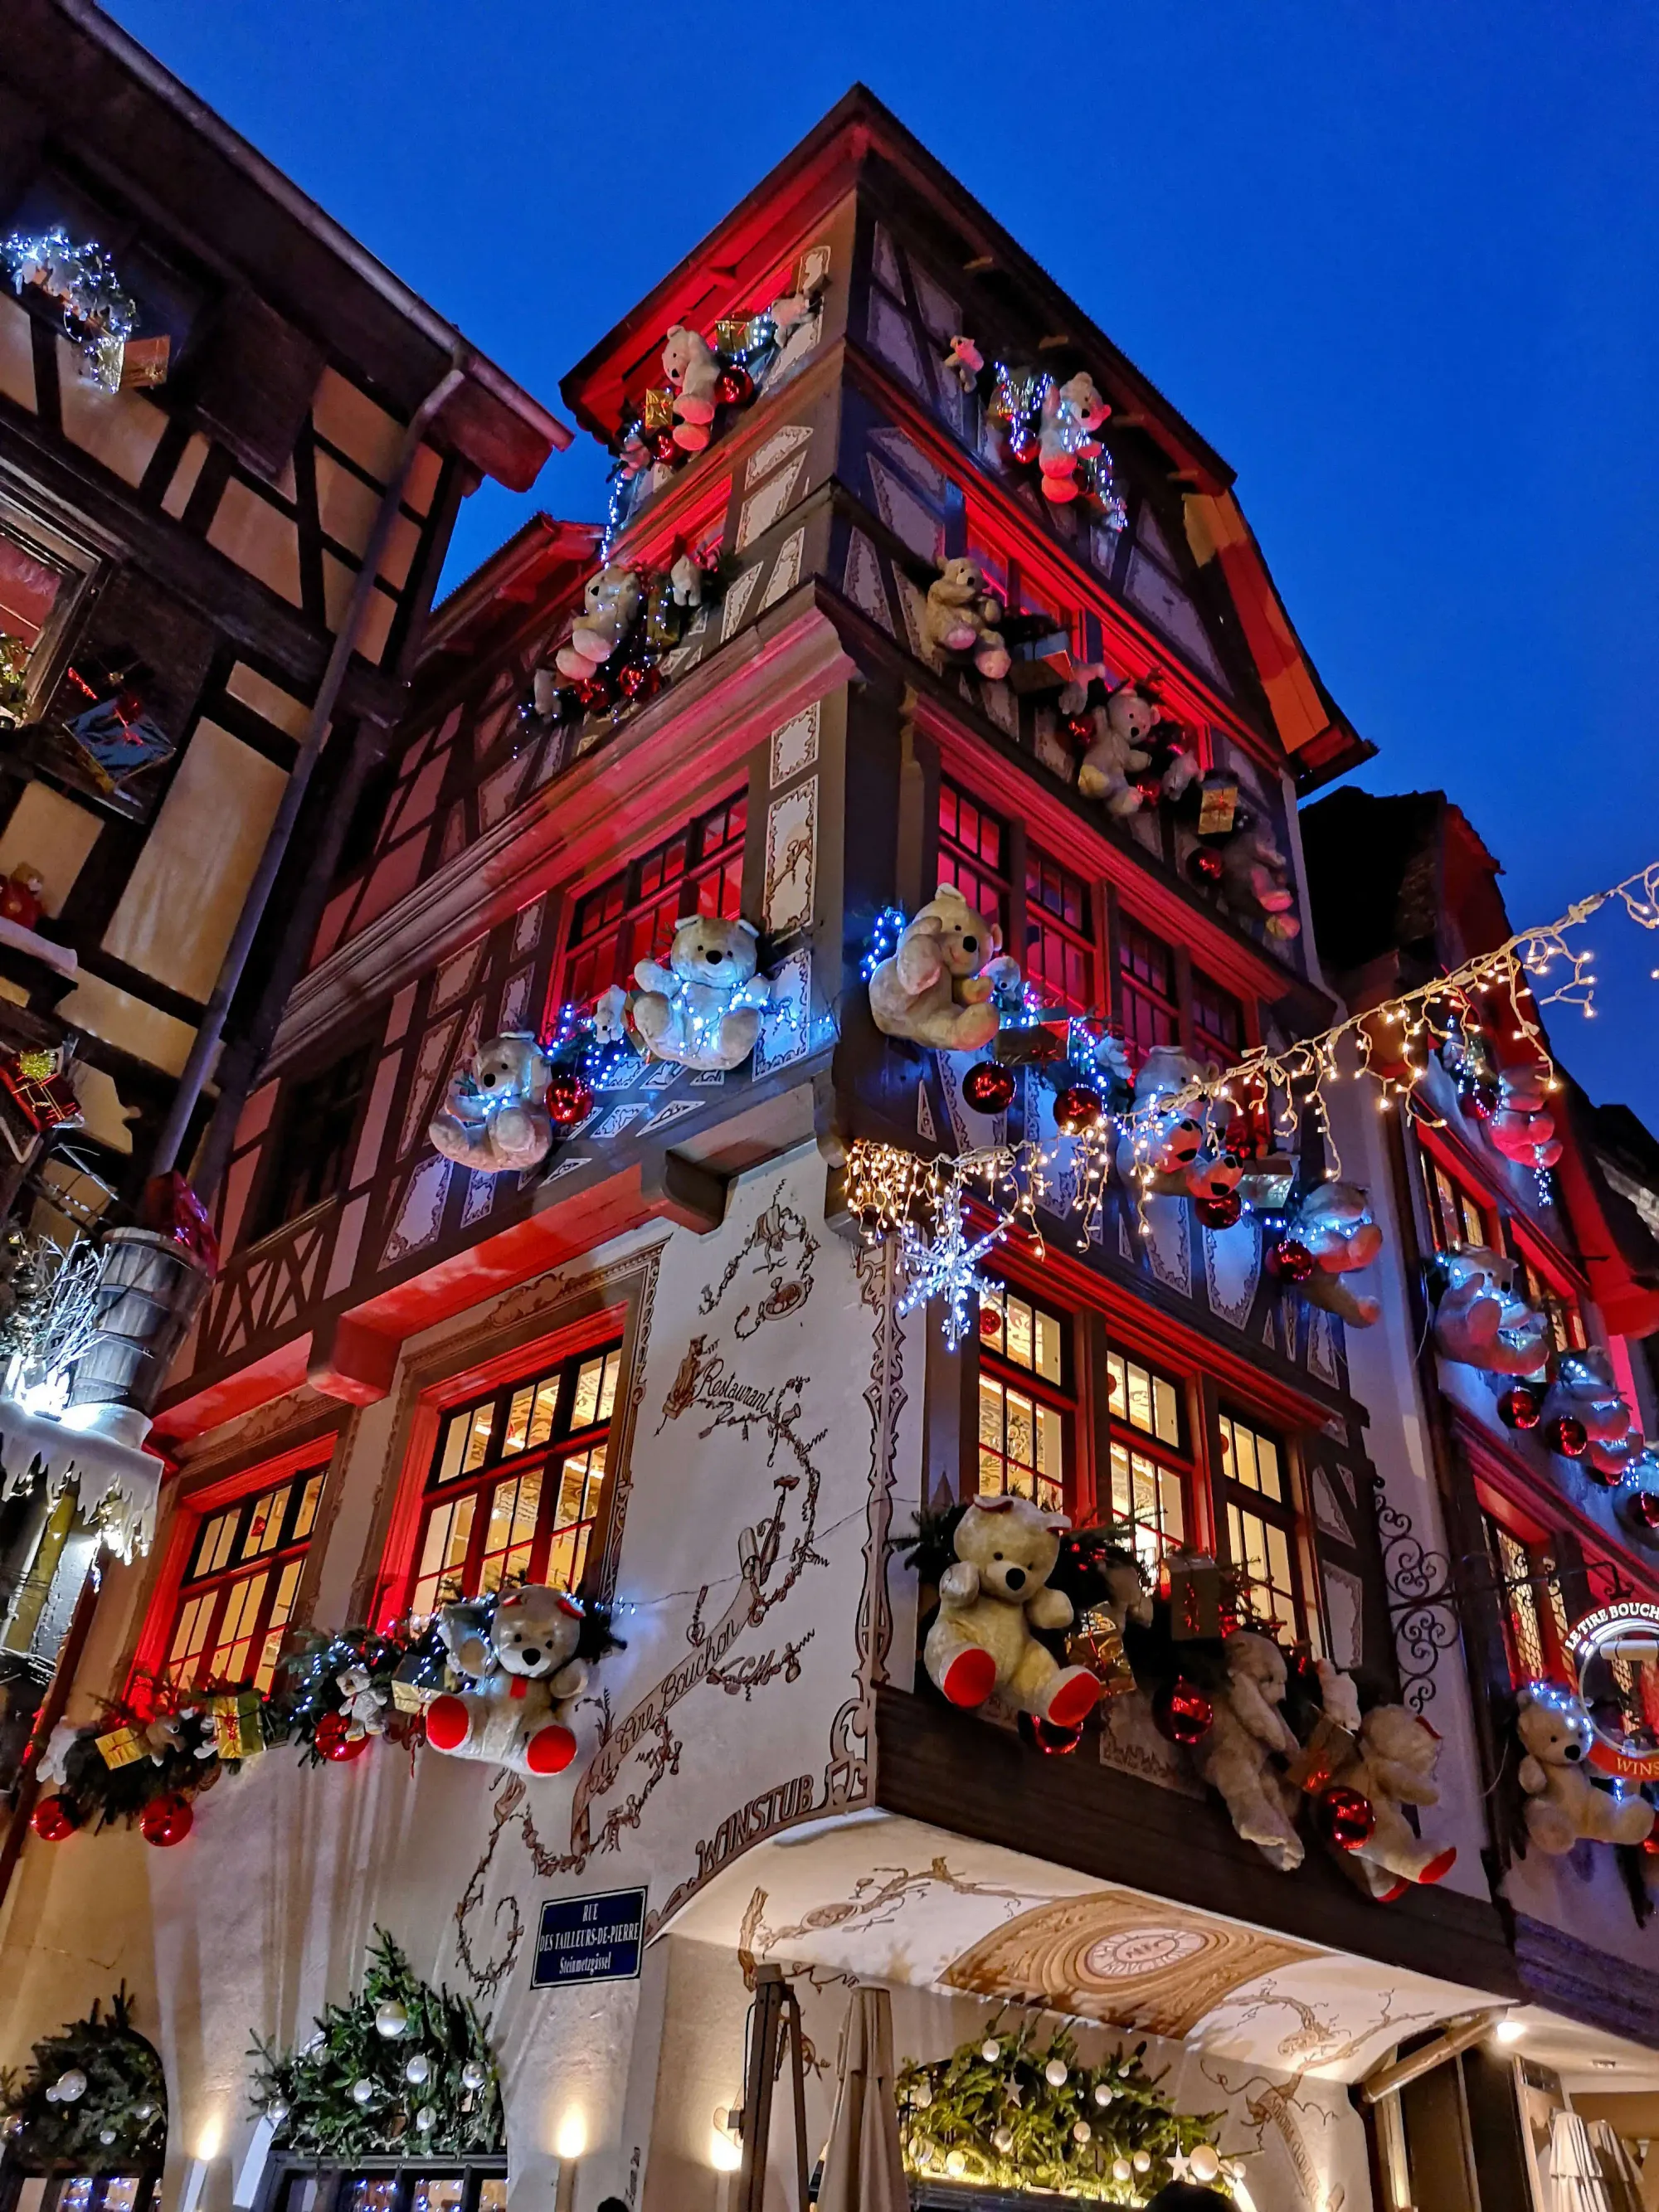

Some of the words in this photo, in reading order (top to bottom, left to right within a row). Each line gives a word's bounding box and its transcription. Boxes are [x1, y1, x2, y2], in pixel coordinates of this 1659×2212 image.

[694, 1357, 776, 1413] Restaurant
[1564, 1630, 1582, 1650] LE
[1577, 1608, 1608, 1636] TIRE
[1608, 1602, 1659, 1621] BOUCH
[657, 1618, 740, 1716] Bouchon
[695, 1774, 815, 1879] WINSTUB
[539, 1933, 554, 1952] DES
[555, 1922, 640, 1950] TAILLEURS-DE-PIERRE
[582, 1903, 599, 1922] RUE
